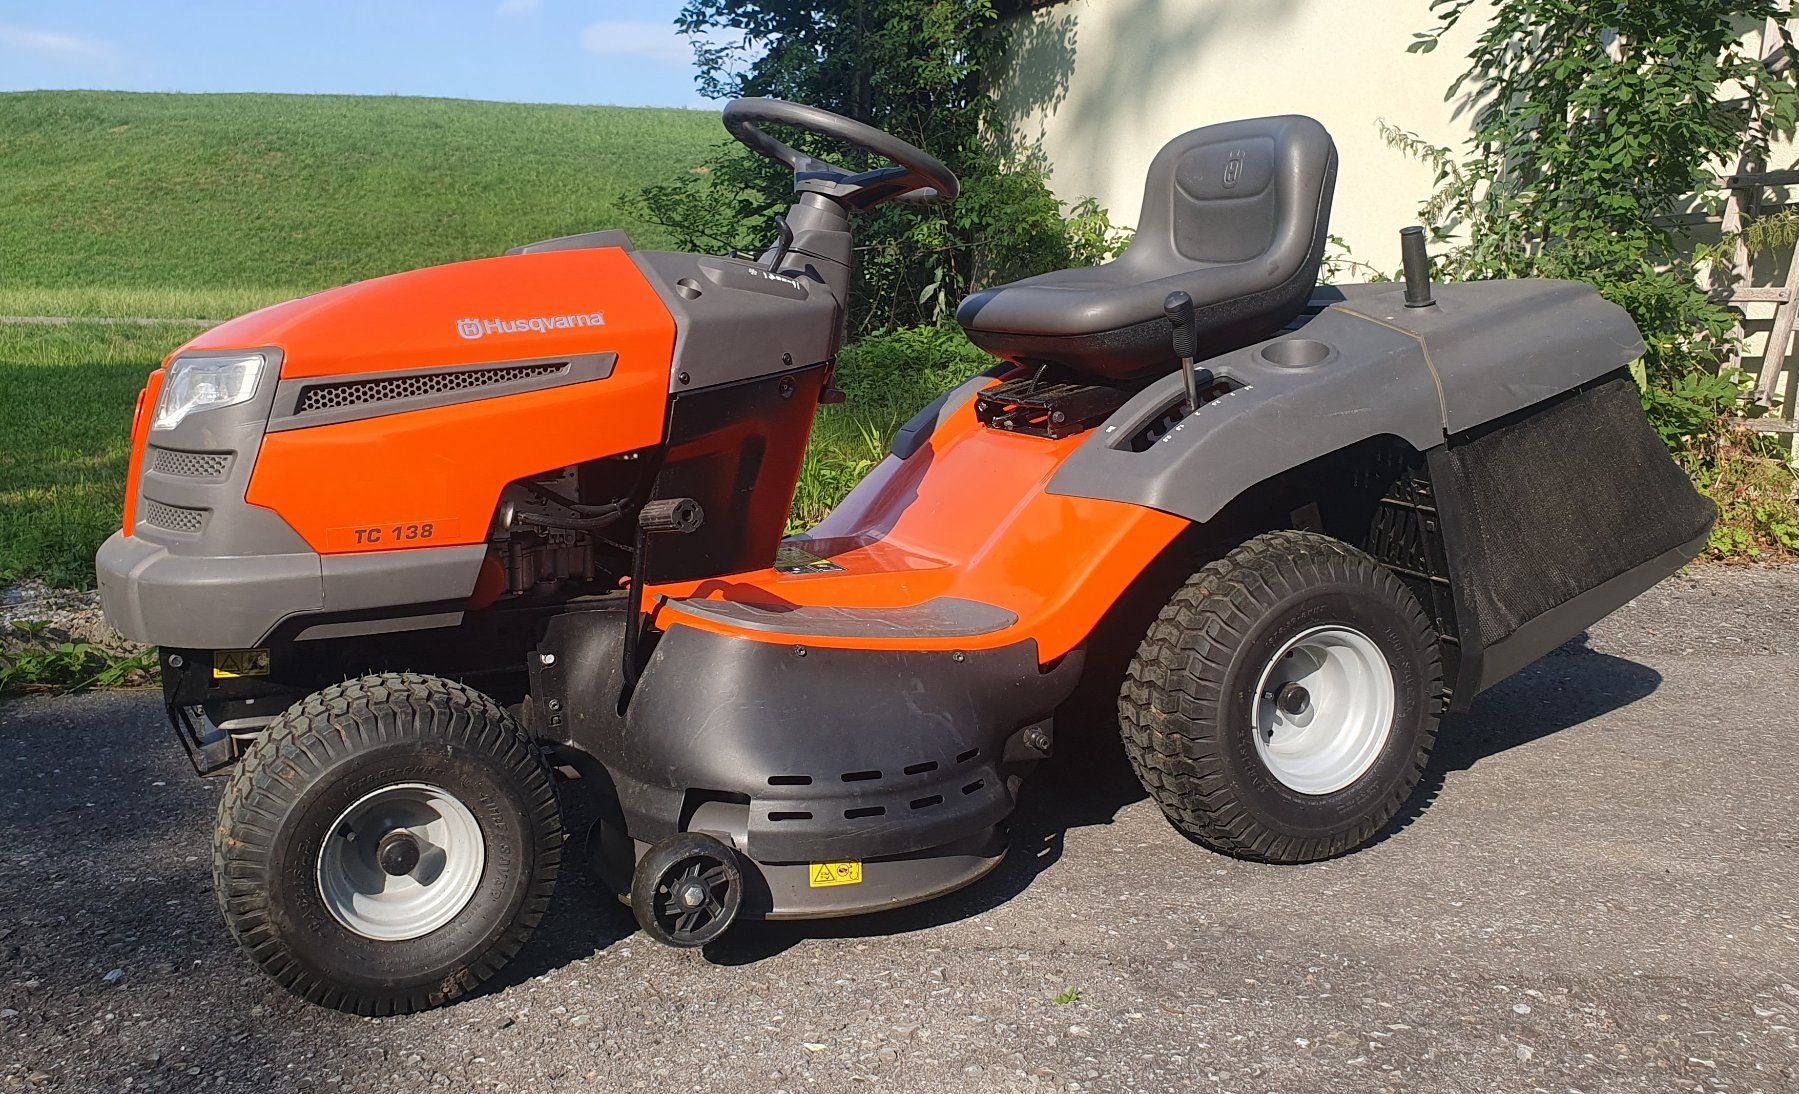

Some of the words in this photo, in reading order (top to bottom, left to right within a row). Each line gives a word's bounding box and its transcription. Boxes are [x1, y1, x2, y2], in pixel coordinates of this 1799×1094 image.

[482, 312, 606, 334] Husqvarna
[354, 528, 382, 544] TC
[391, 523, 434, 541] 138
